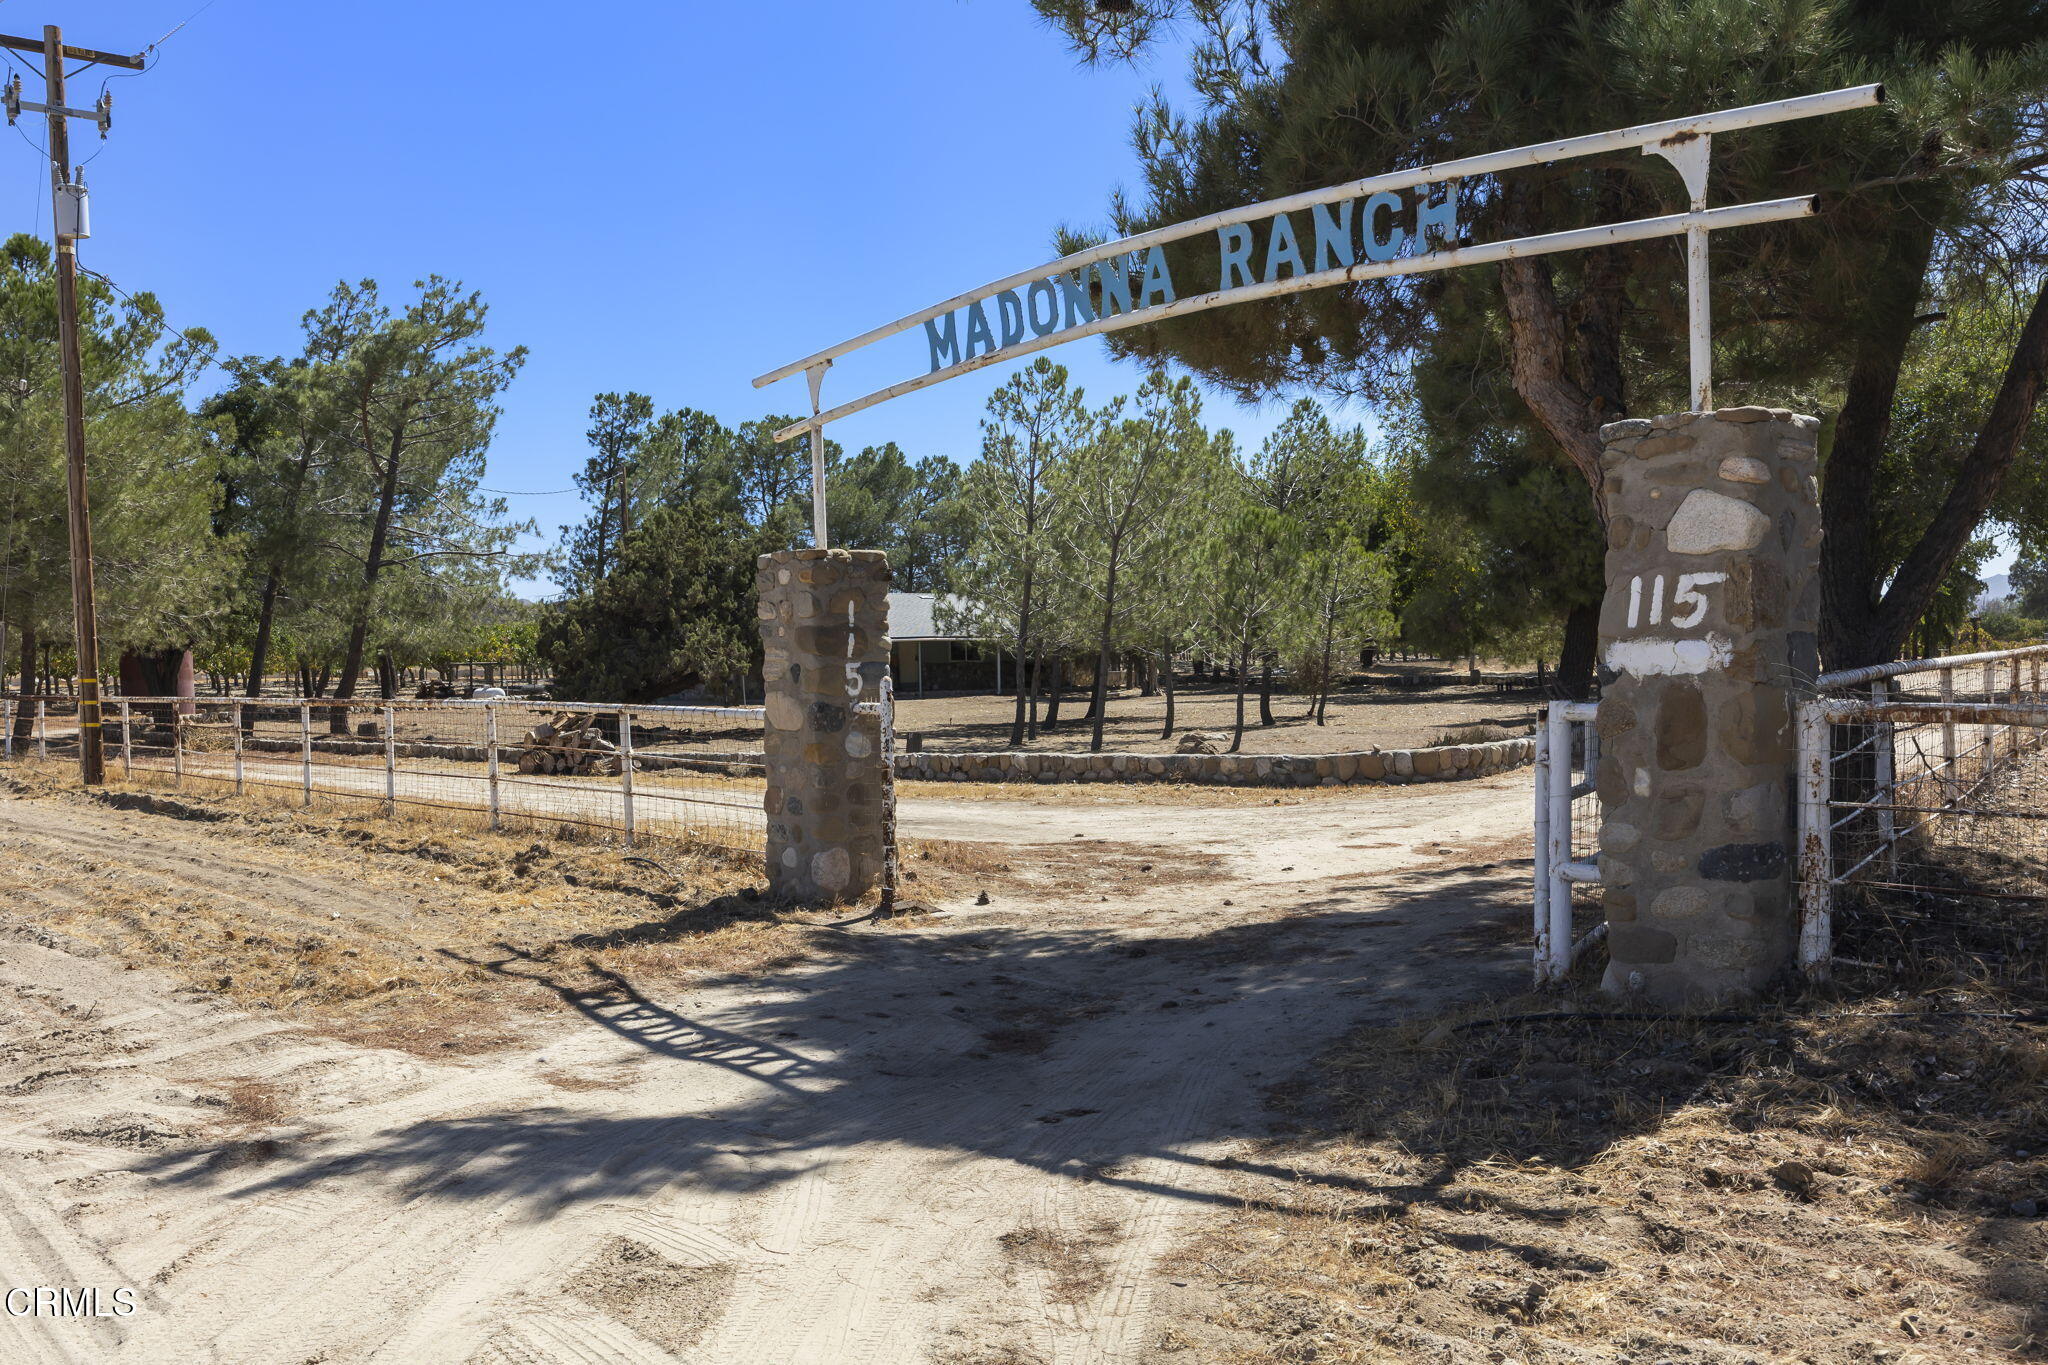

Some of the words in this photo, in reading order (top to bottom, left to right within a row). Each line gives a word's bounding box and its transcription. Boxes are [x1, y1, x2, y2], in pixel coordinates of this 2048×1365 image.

[924, 244, 1176, 374] MADONNA
[1217, 177, 1461, 291] RANCH
[1627, 571, 1729, 629] 115
